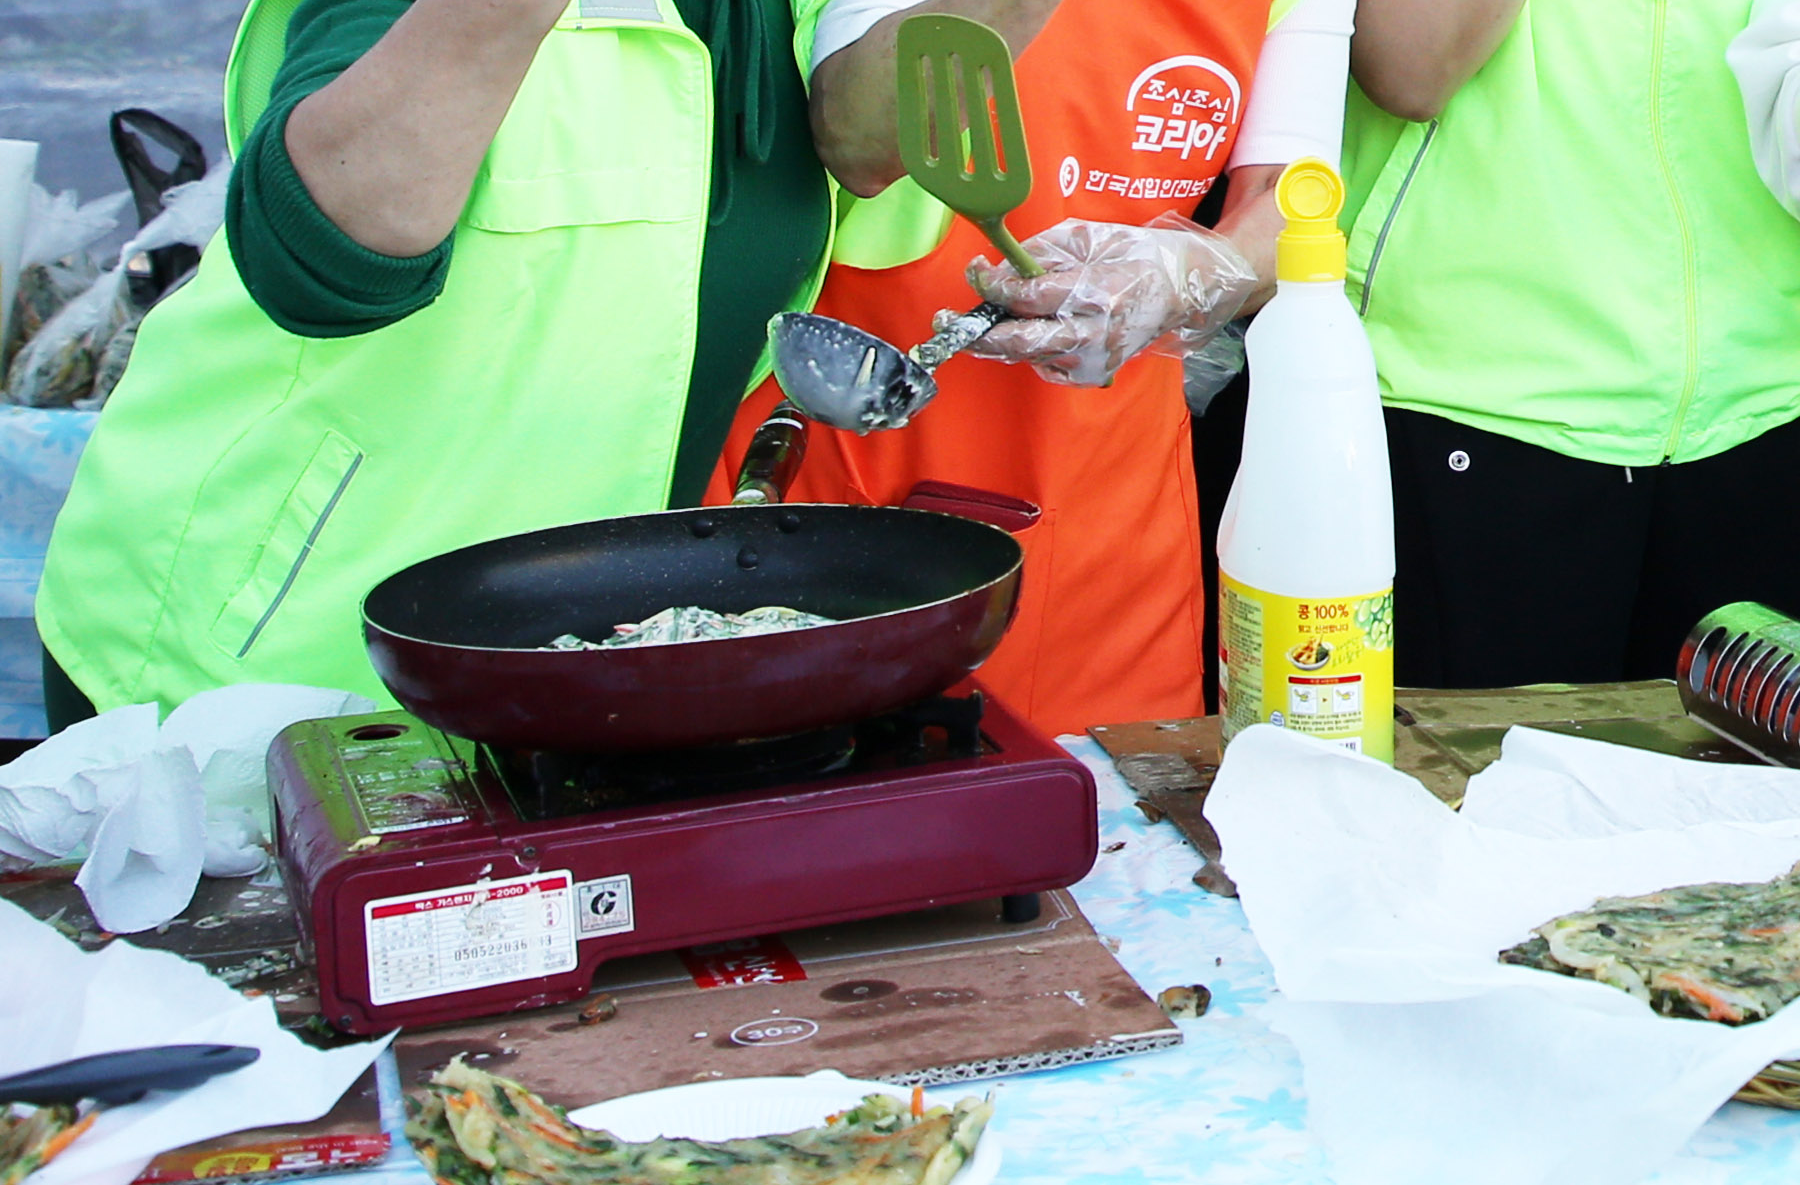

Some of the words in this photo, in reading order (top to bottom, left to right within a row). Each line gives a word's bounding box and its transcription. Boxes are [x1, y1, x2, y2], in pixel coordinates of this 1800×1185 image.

[1142, 78, 1232, 124] 조심조심
[1131, 114, 1228, 162] 코리아
[1314, 604, 1350, 620] 100%
